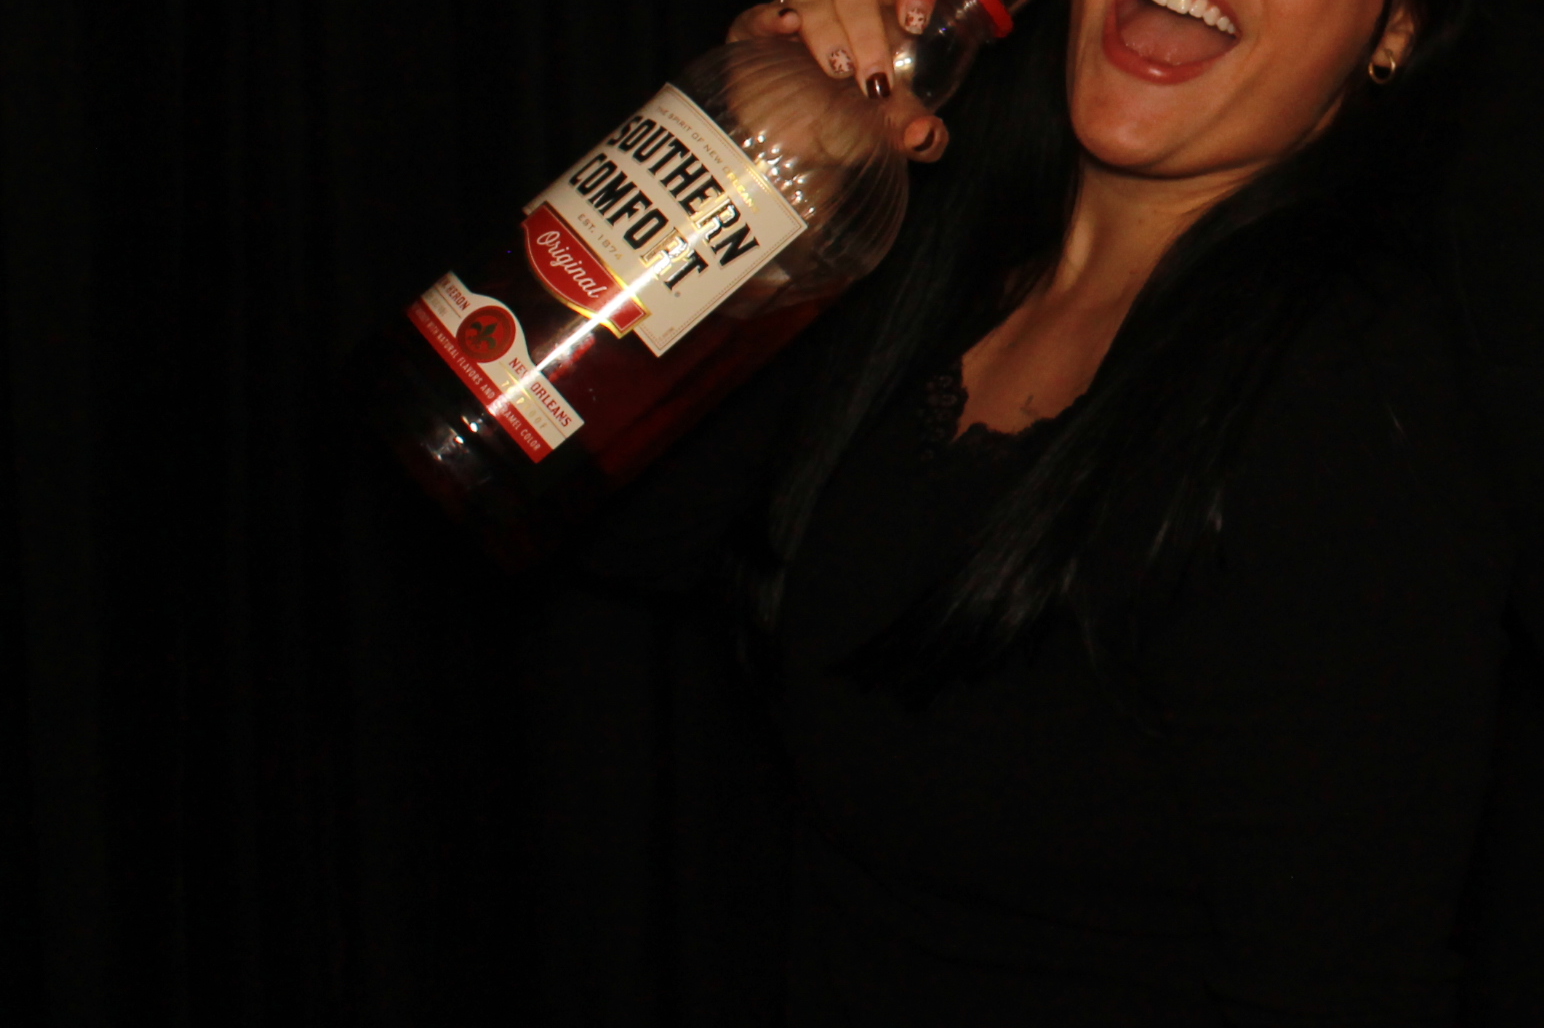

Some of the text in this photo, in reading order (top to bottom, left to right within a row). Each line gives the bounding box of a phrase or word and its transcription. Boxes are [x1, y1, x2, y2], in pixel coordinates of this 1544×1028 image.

[607, 114, 760, 267] SOUTHERN
[667, 110, 693, 133] SPIRIT
[691, 131, 705, 146] OF
[703, 144, 723, 164] NEW
[722, 166, 760, 213] ORLEANS
[536, 230, 608, 299] Original
[568, 153, 709, 290] COMFORT
[577, 214, 623, 262] EST. 1874
[437, 333, 459, 359] NATURAL
[456, 356, 483, 386] FLAVORS
[481, 384, 496, 400] AND
[520, 429, 541, 452] COLOR
[530, 382, 573, 428] ORLEANS
